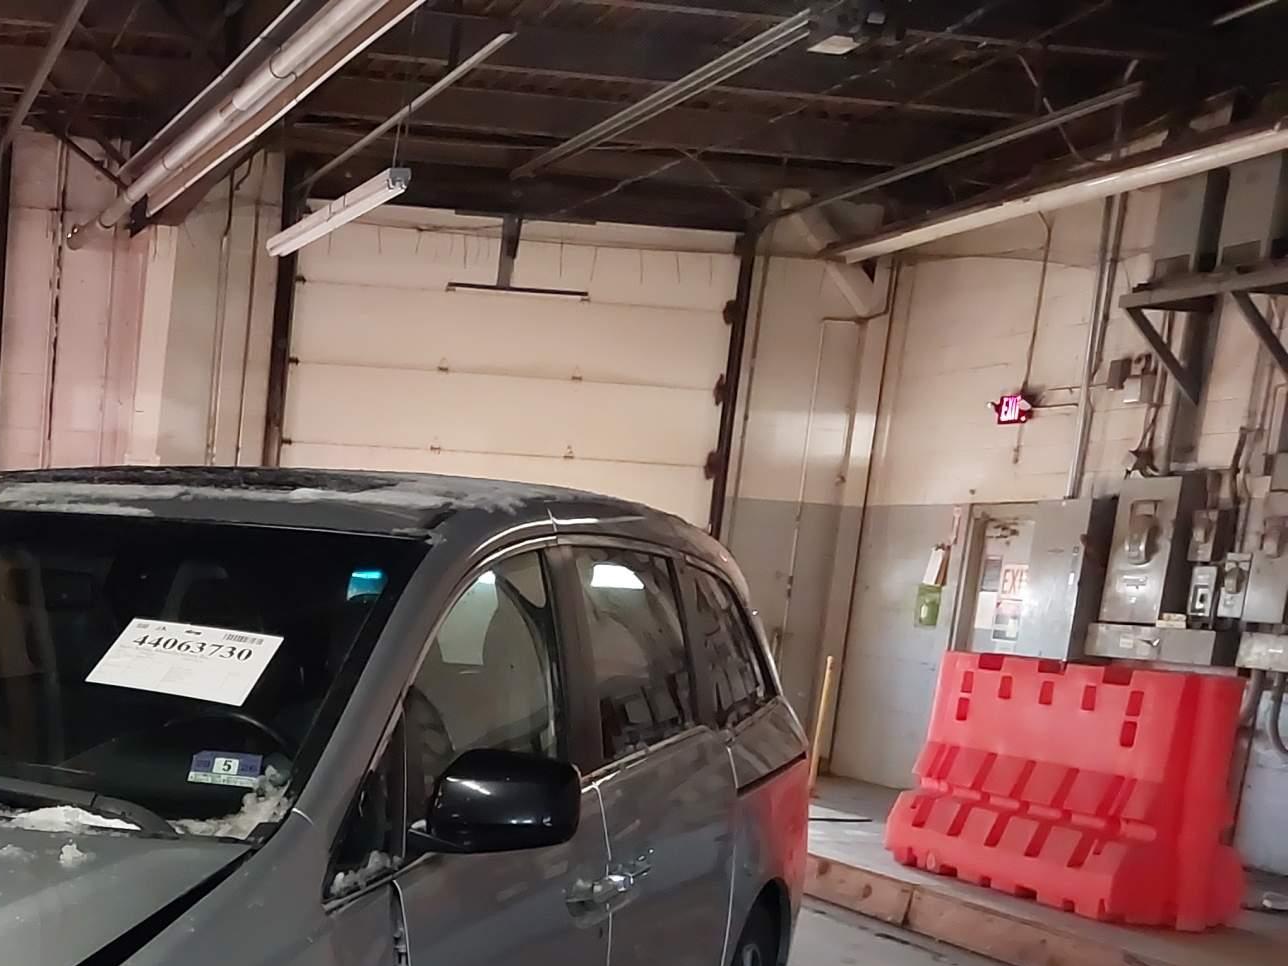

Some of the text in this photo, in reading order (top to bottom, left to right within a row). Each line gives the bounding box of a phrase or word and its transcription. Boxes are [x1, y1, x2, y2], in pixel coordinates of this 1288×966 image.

[1001, 569, 1029, 594] EXI
[133, 634, 253, 661] 44063730
[222, 759, 233, 772] 5
